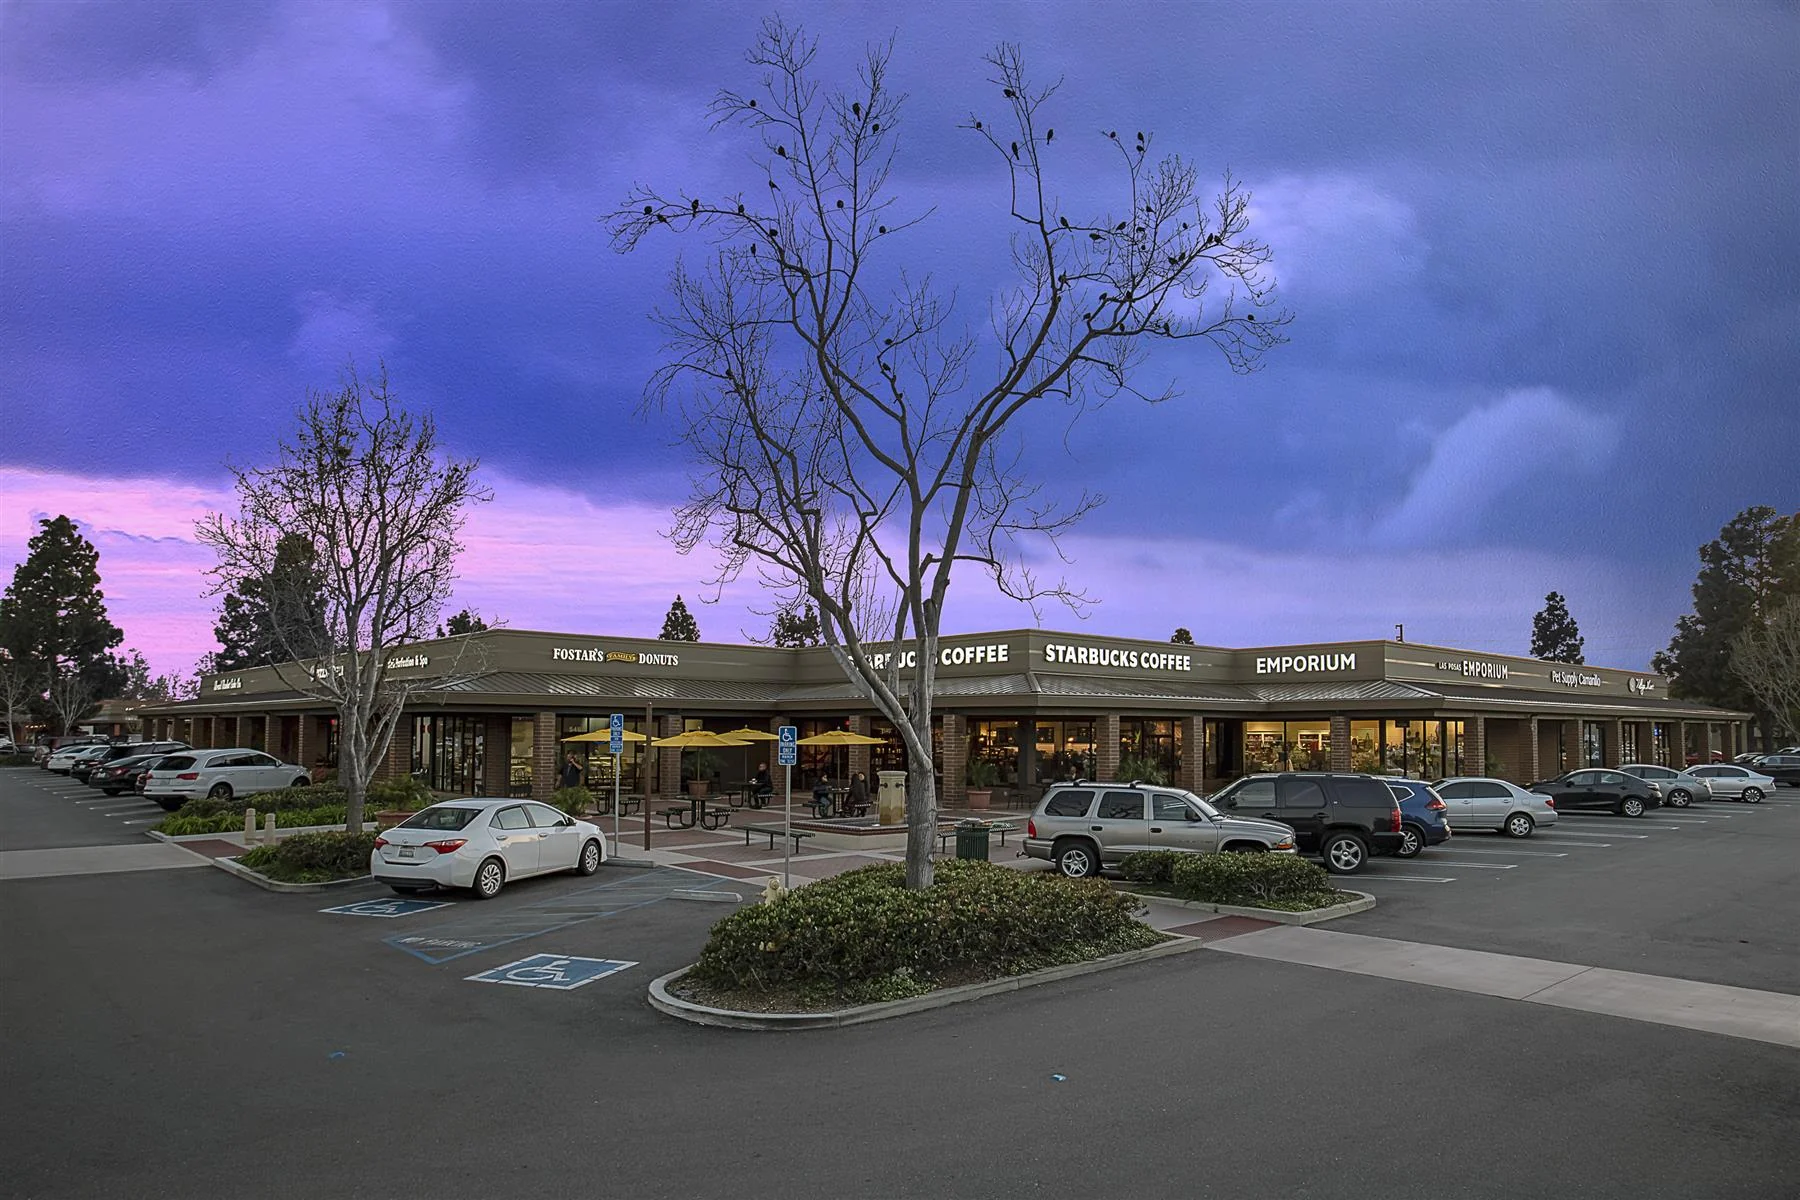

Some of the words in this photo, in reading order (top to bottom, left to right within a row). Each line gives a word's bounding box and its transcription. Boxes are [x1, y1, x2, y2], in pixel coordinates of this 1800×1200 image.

[552, 648, 604, 662] FOSTAR'S
[638, 653, 679, 666] DONUTS
[941, 644, 1009, 666] COFFEE
[1045, 643, 1138, 668] STARBUCKS
[1140, 652, 1191, 671] COFFEE
[1256, 653, 1356, 674] EMPORIUM
[1438, 661, 1447, 670] LAS
[1448, 662, 1462, 671] POSAS
[1463, 660, 1508, 679] EMPORIUM
[1552, 670, 1561, 683] Pet
[1561, 671, 1578, 687] Supply
